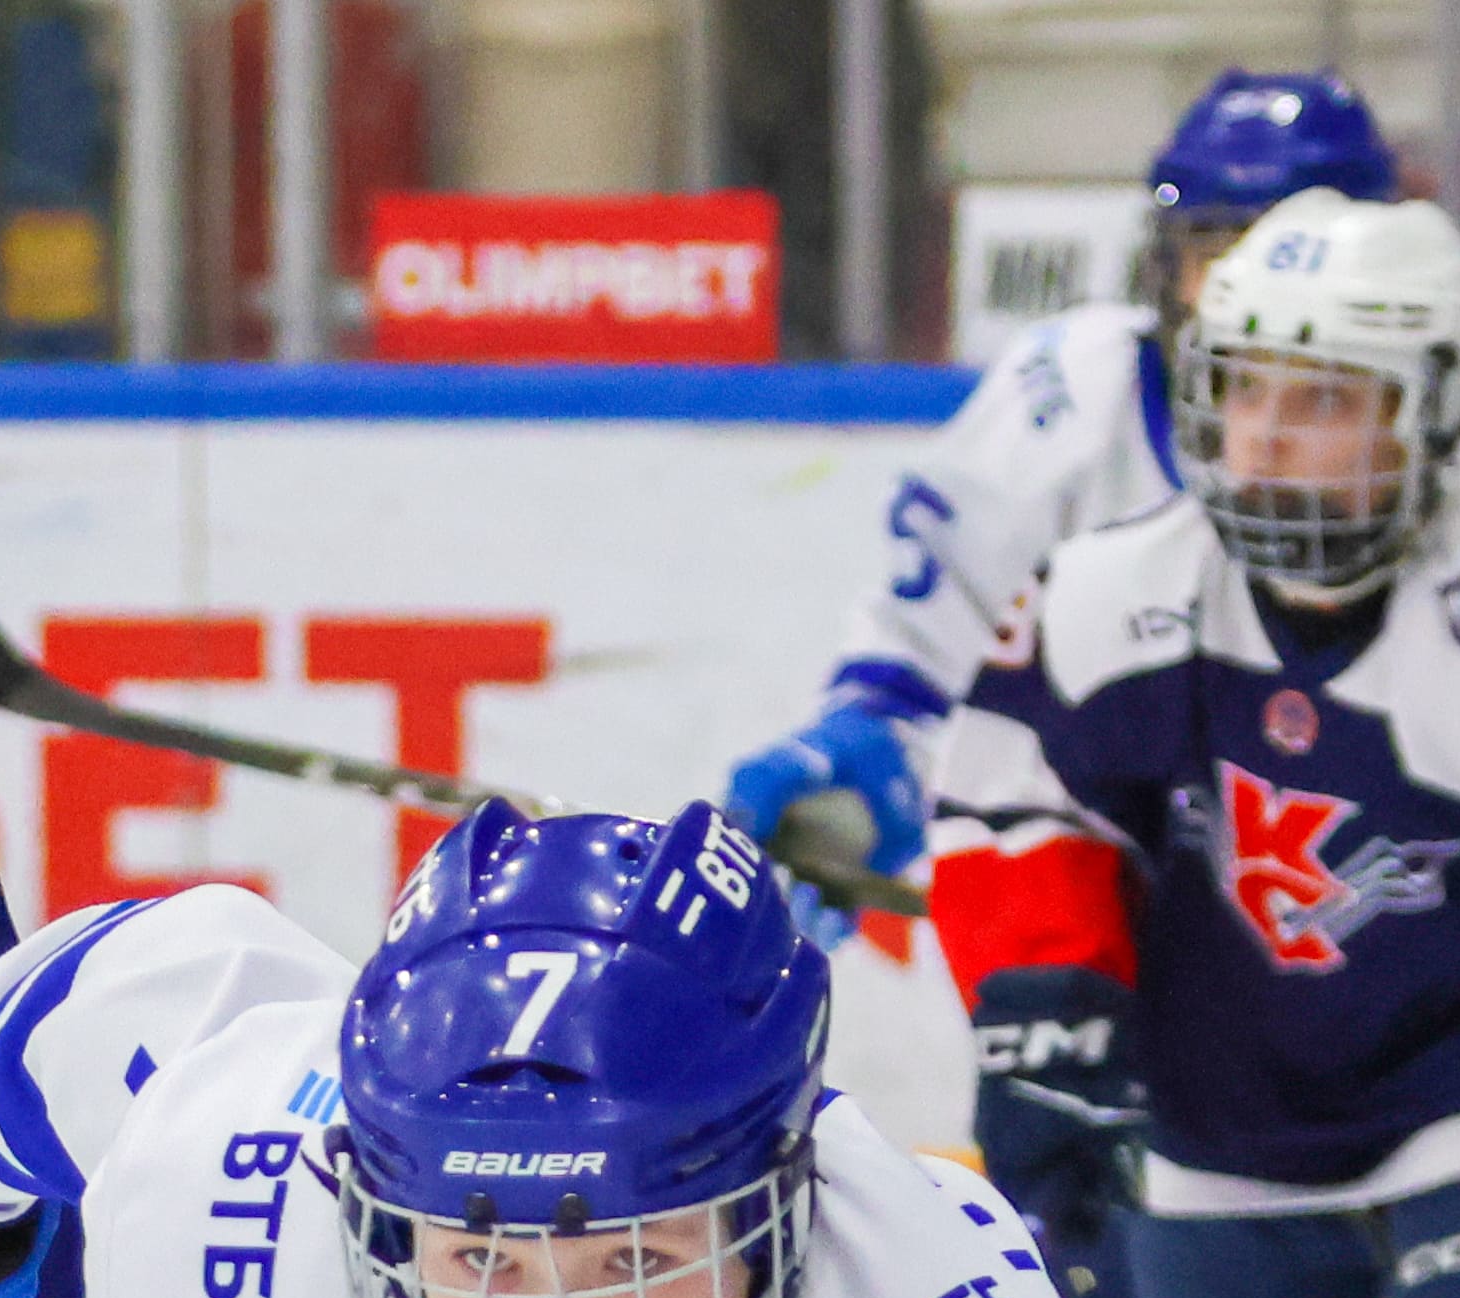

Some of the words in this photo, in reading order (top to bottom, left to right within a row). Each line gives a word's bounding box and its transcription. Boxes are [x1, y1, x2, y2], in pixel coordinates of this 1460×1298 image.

[375, 240, 768, 318] OLIMPBET
[502, 951, 578, 1056] 7
[975, 1018, 1113, 1075] CM
[442, 1151, 607, 1177] BAUER
